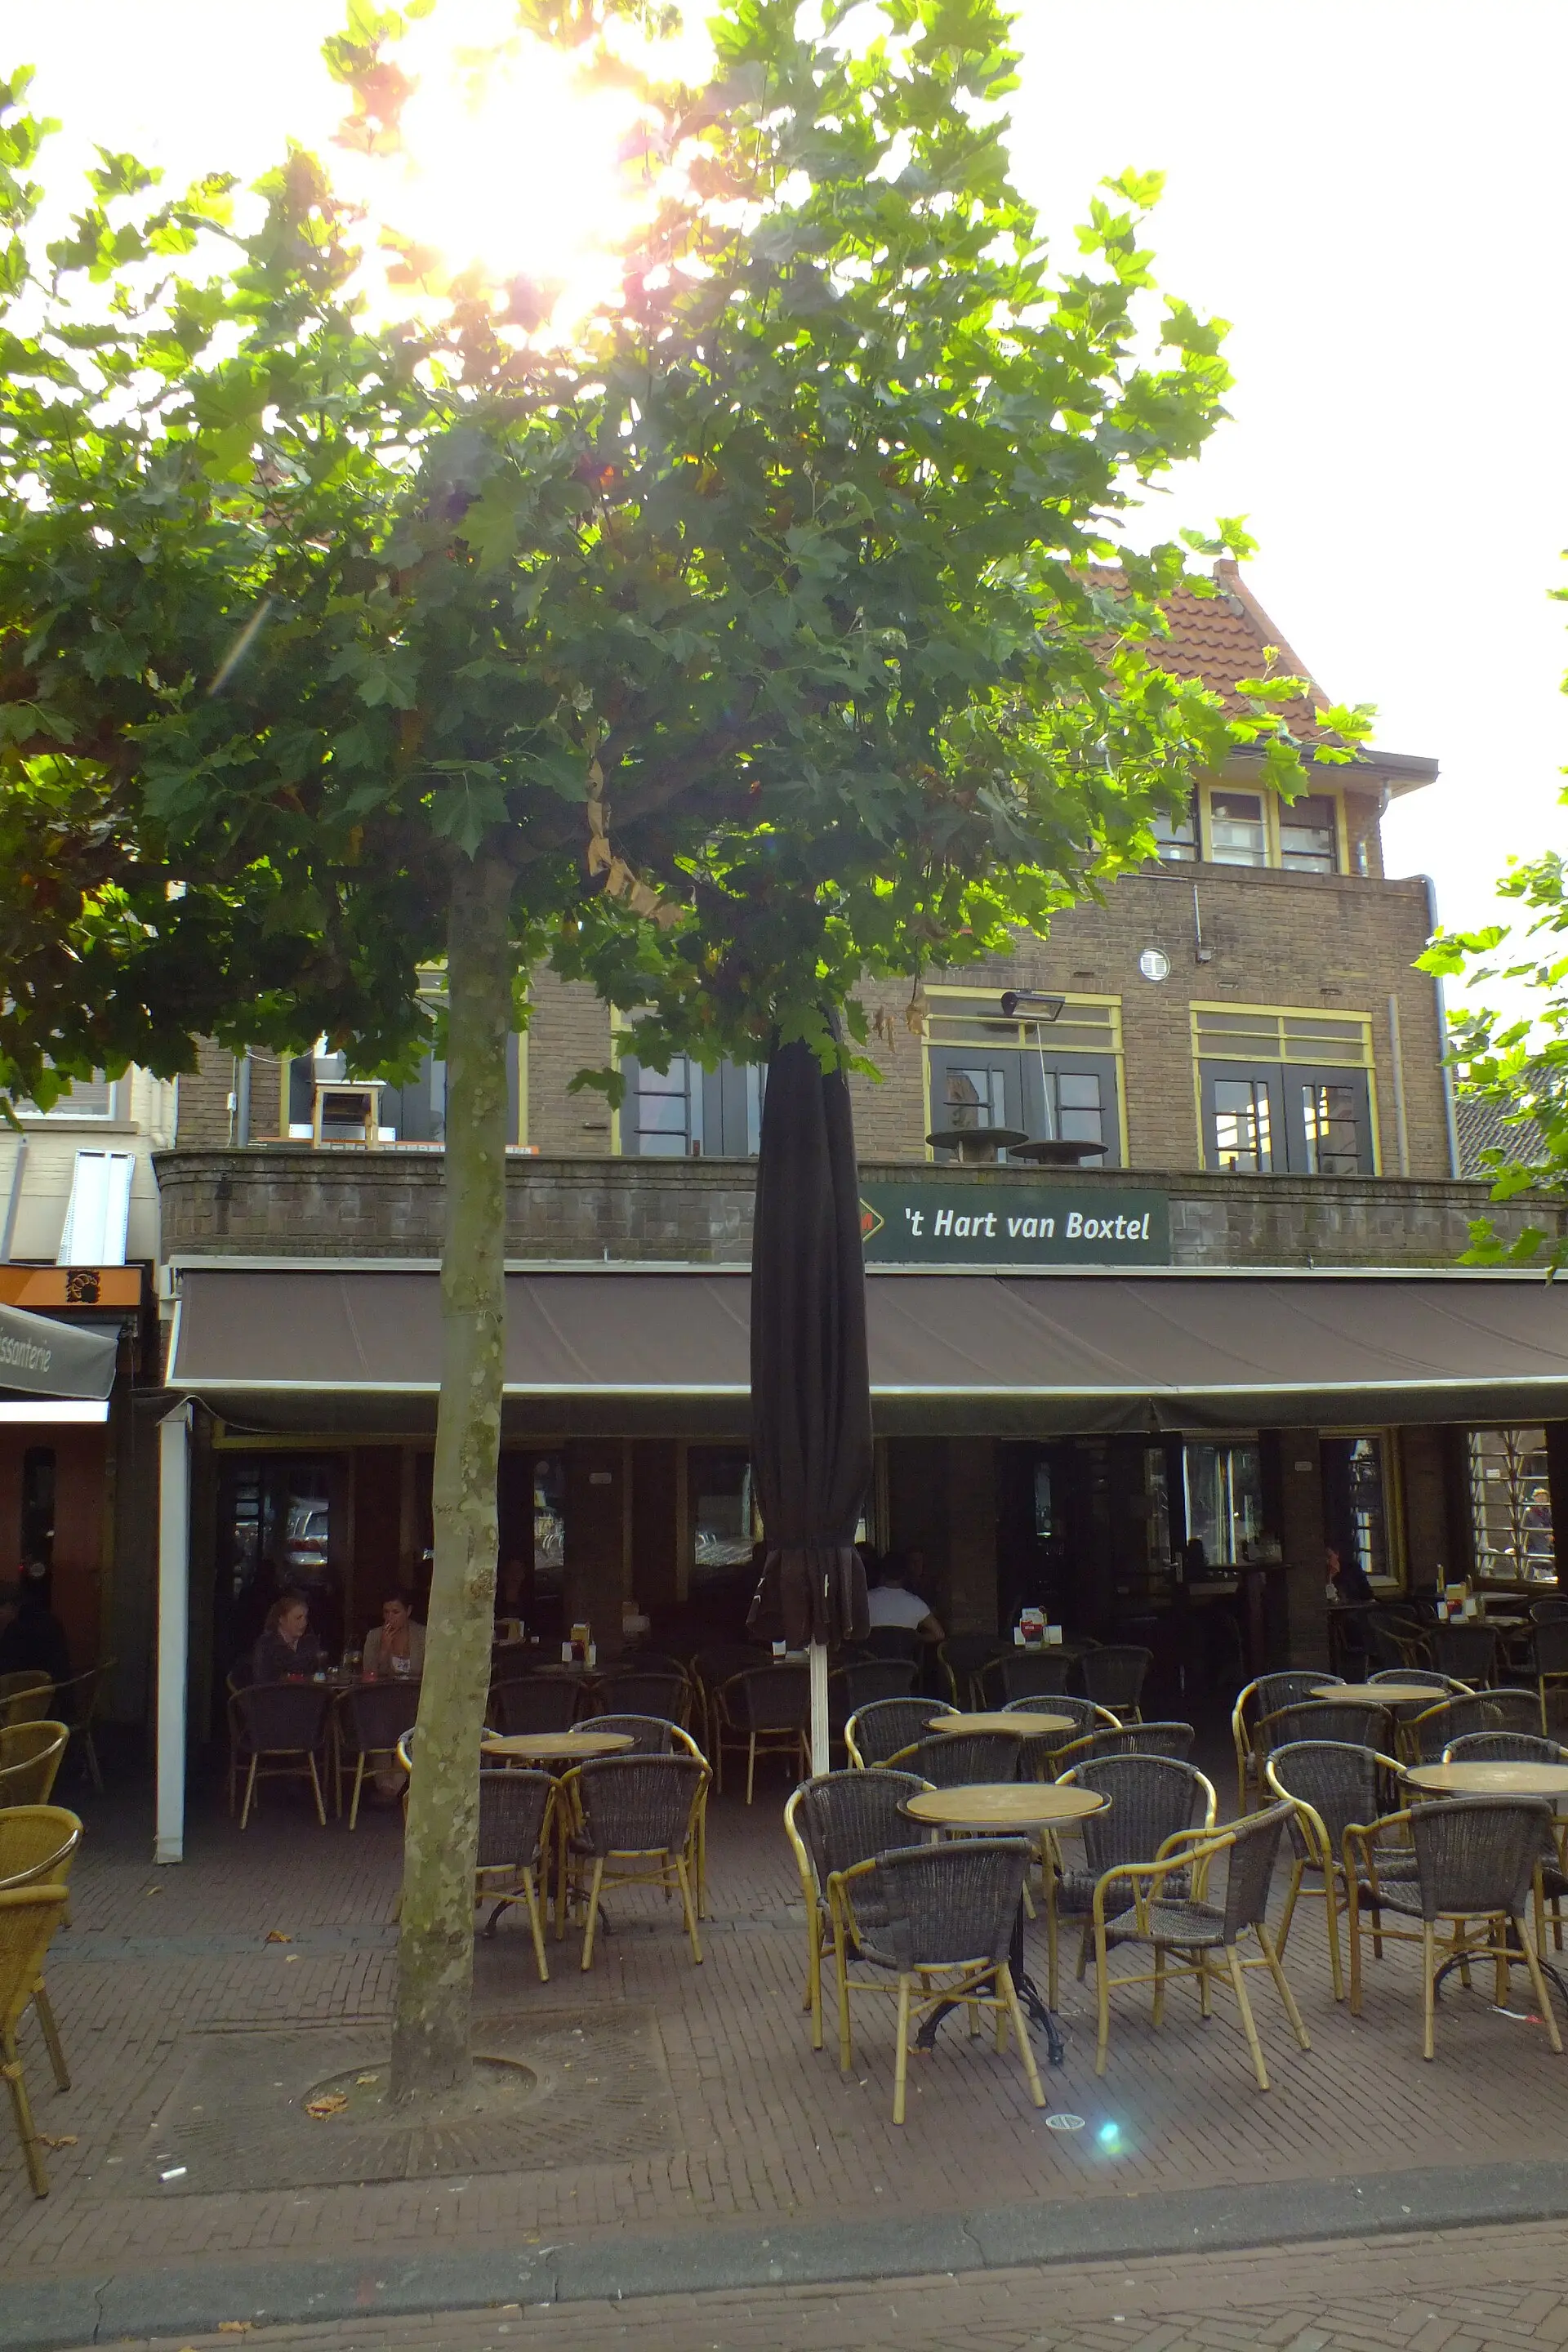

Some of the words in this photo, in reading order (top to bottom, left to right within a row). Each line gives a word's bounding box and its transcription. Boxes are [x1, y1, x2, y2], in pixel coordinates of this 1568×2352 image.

[906, 1208, 924, 1236] 't
[934, 1209, 997, 1237] Hart
[1008, 1217, 1055, 1238] van
[1066, 1212, 1150, 1240] Boxtel
